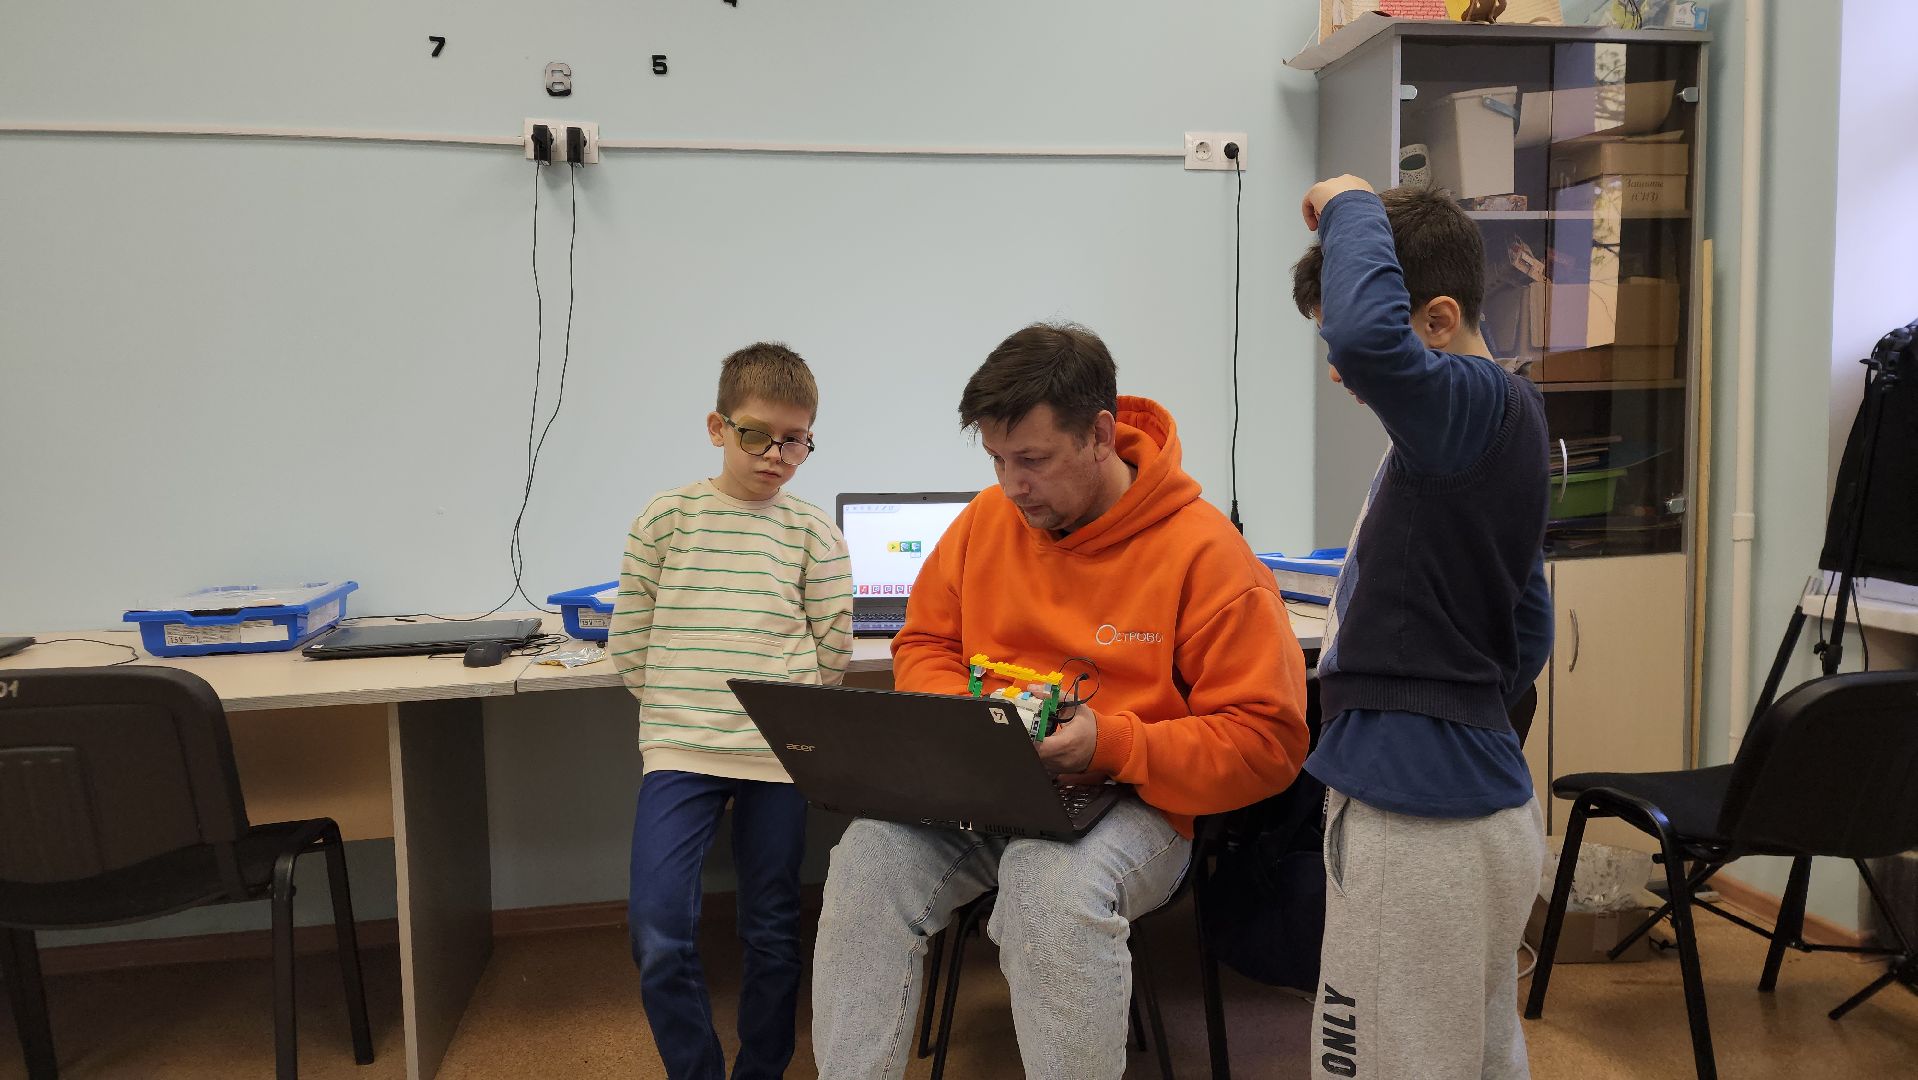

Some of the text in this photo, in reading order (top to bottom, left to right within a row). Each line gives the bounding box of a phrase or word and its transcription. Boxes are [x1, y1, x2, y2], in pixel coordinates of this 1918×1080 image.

[429, 35, 446, 58] 7
[651, 54, 668, 75] 5
[544, 62, 572, 97] 6
[785, 743, 816, 752] acer
[1321, 982, 1357, 1079] ONLY
